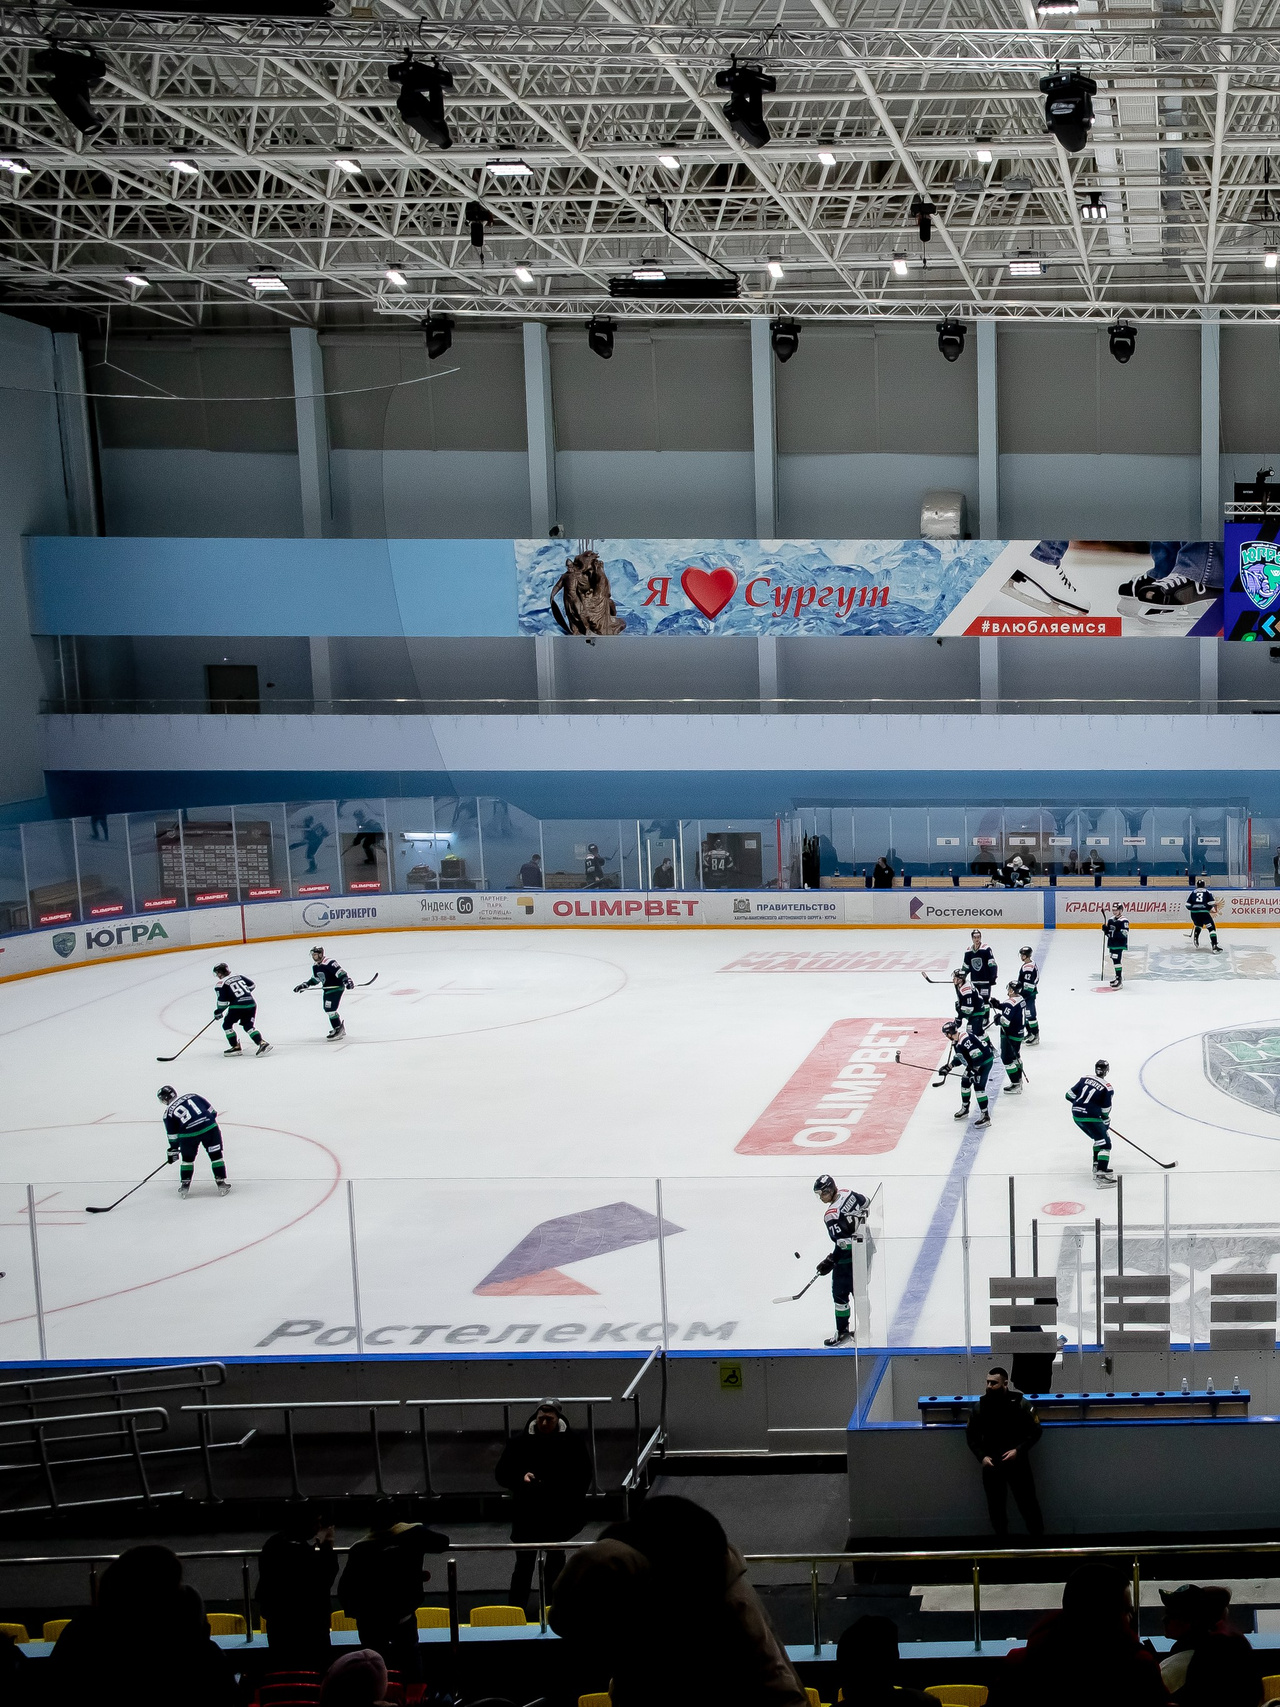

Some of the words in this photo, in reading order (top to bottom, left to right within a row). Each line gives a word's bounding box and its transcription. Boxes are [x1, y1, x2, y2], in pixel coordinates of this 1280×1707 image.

[640, 577, 672, 606] Я
[744, 578, 890, 618] Сургут
[981, 620, 1106, 634] #влюбляемся
[712, 858, 724, 870] 84
[1196, 892, 1203, 902] 3
[420, 899, 454, 912] Яндекс
[458, 900, 472, 912] Go
[552, 900, 700, 917] OLIMPBET
[926, 906, 1003, 918] Ростелеком
[1122, 902, 1167, 912] МАШИНА
[330, 908, 377, 920] БУРЭНЕРГО
[86, 922, 169, 950] ЮГРА
[741, 950, 911, 958] КРАСНАЯ
[720, 958, 951, 970] МАШИНА
[229, 980, 252, 998] 96
[964, 1040, 973, 1050] 52
[792, 1022, 916, 1148] OLIMPBET
[173, 1098, 202, 1124] 91
[829, 1223, 842, 1236] 75
[254, 1318, 739, 1348] Ростелеком
